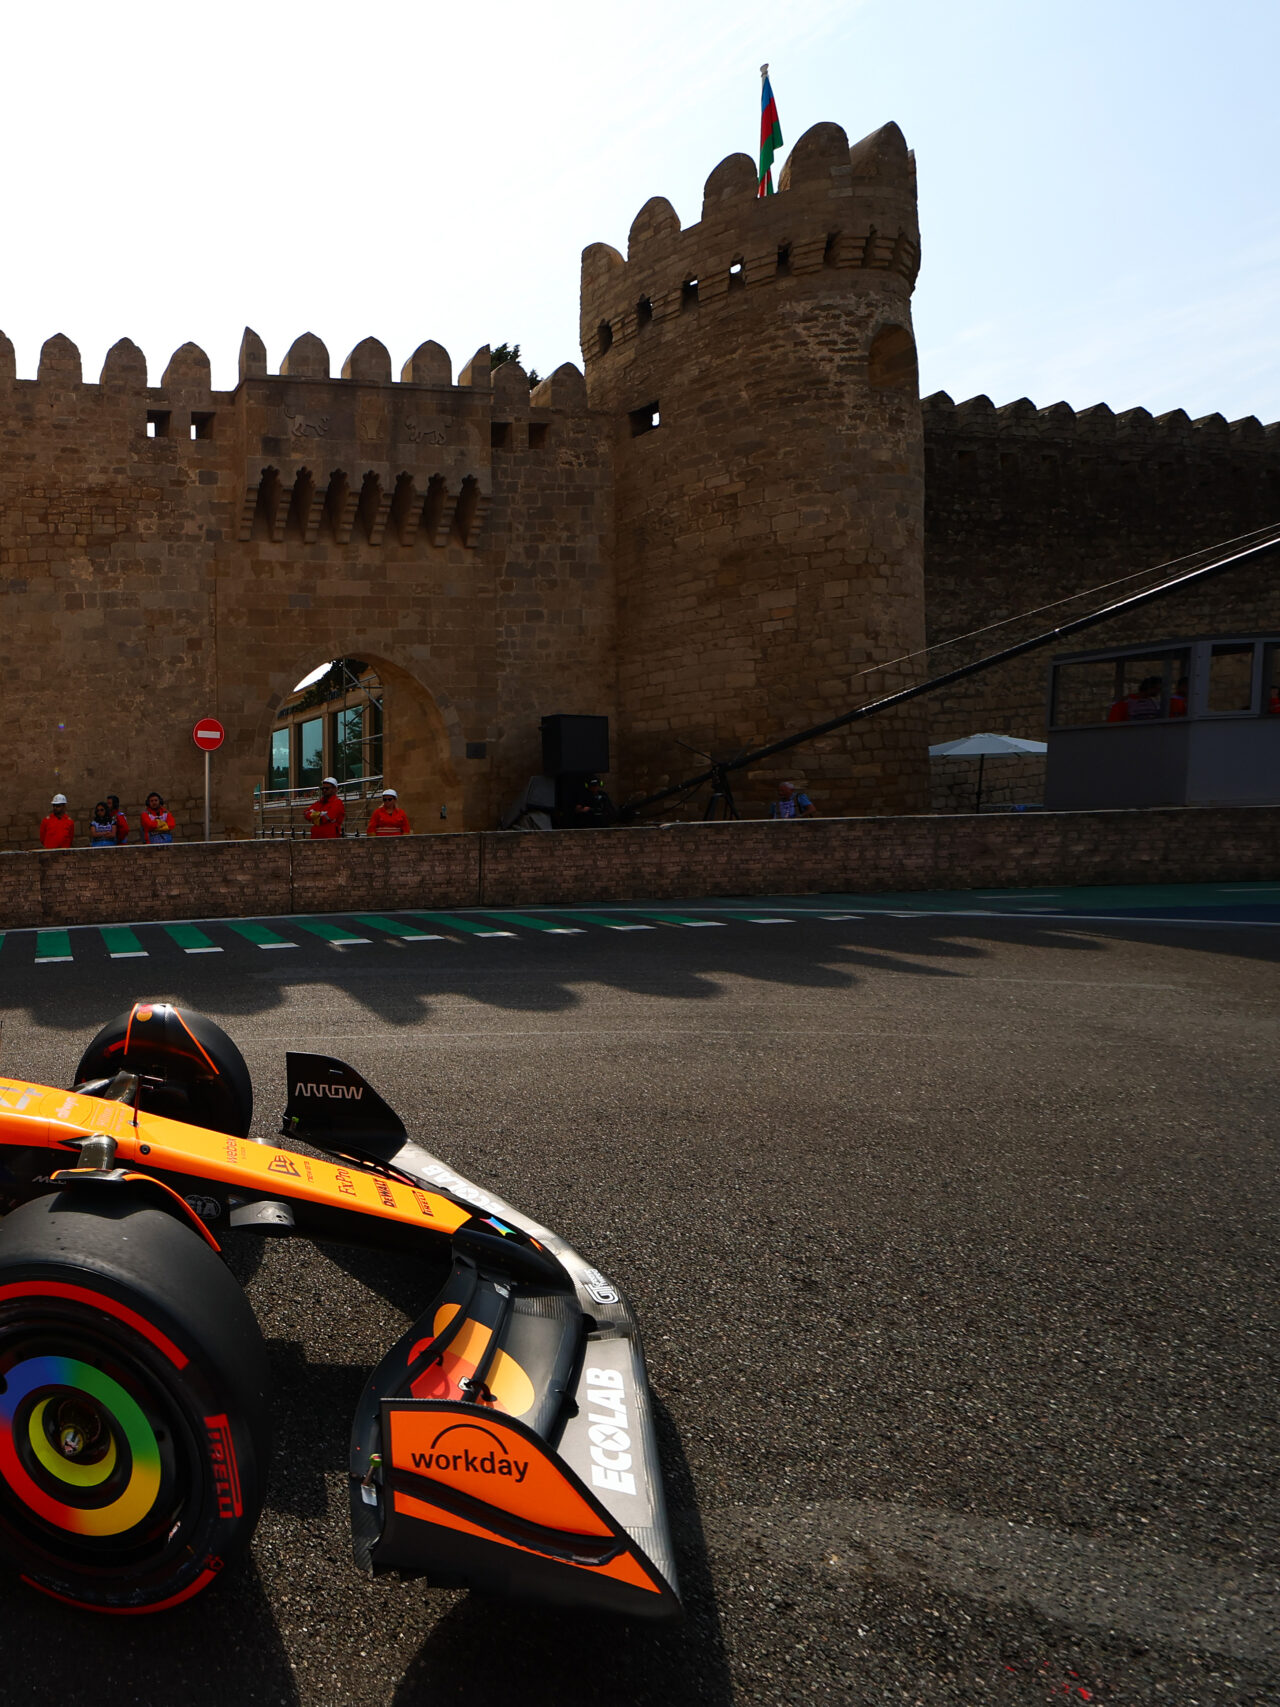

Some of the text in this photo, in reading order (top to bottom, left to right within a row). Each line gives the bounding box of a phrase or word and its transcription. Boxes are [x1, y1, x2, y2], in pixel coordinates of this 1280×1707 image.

[295, 1082, 363, 1100] ARROW
[335, 1168, 357, 1197] FxPro
[373, 1177, 397, 1209] DEWALT
[420, 1164, 505, 1214] ECOLAB
[586, 1367, 637, 1496] ECOLAB
[204, 1413, 244, 1519] PIRELLI
[411, 1449, 529, 1483] workday
